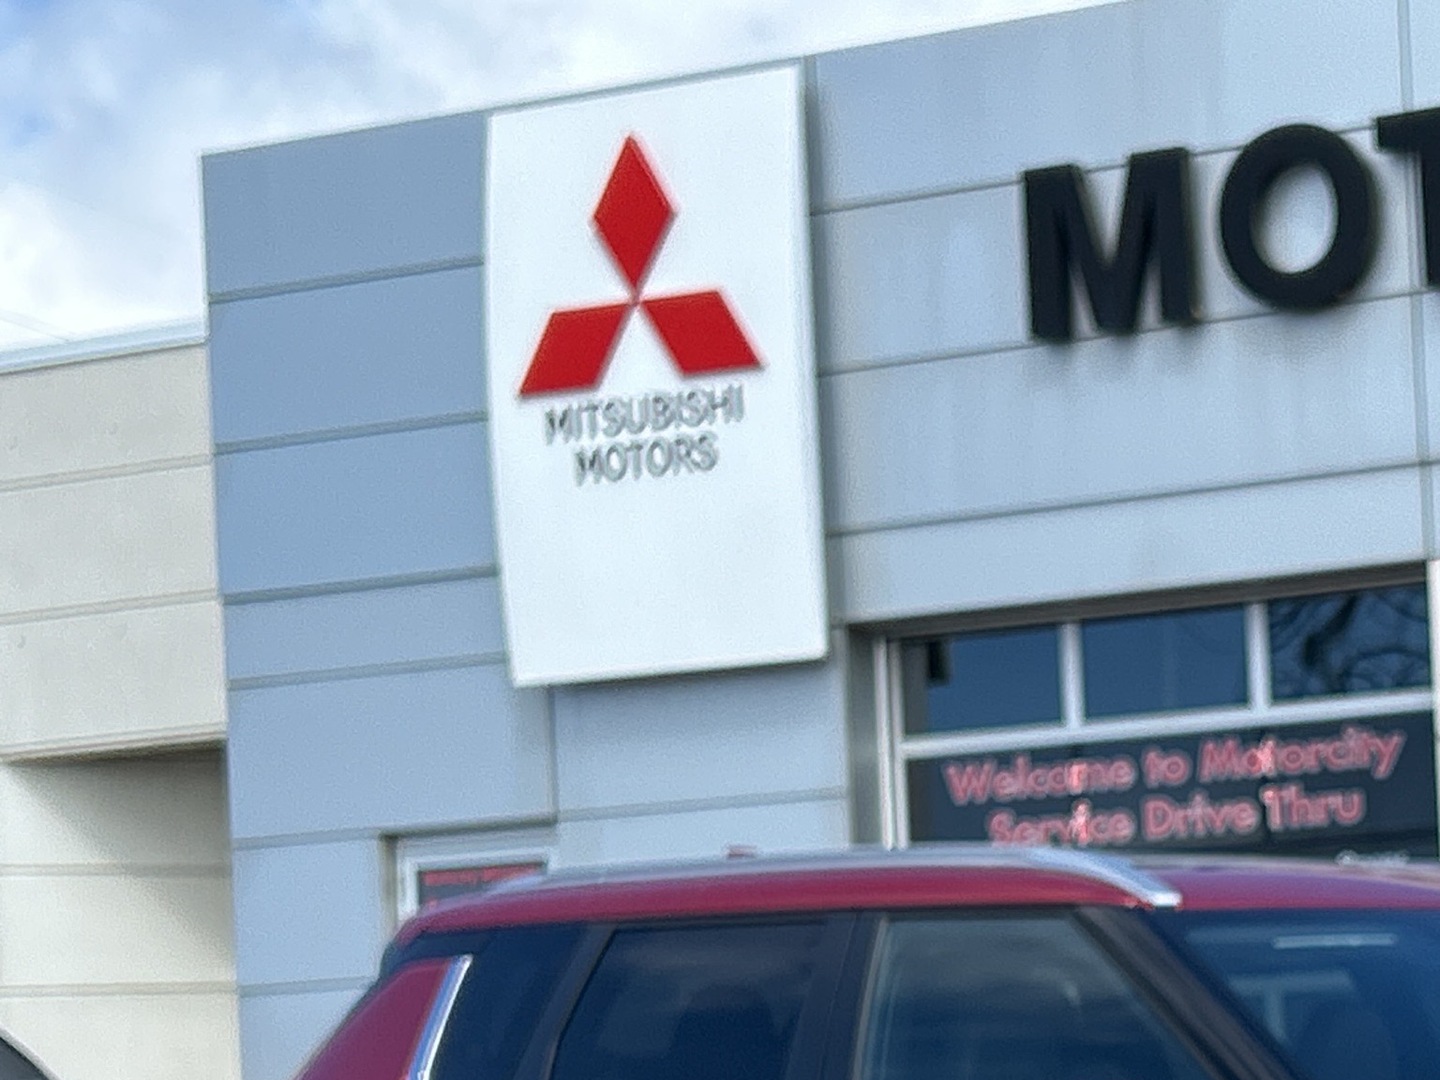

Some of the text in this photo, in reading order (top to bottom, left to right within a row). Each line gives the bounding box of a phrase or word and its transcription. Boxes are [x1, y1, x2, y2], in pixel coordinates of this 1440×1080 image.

[545, 385, 746, 445] MITSUBISHI
[574, 434, 719, 487] MOTORS
[943, 726, 1404, 804] Welcome to Motorcity
[988, 782, 1365, 845] Service Drive Thru
